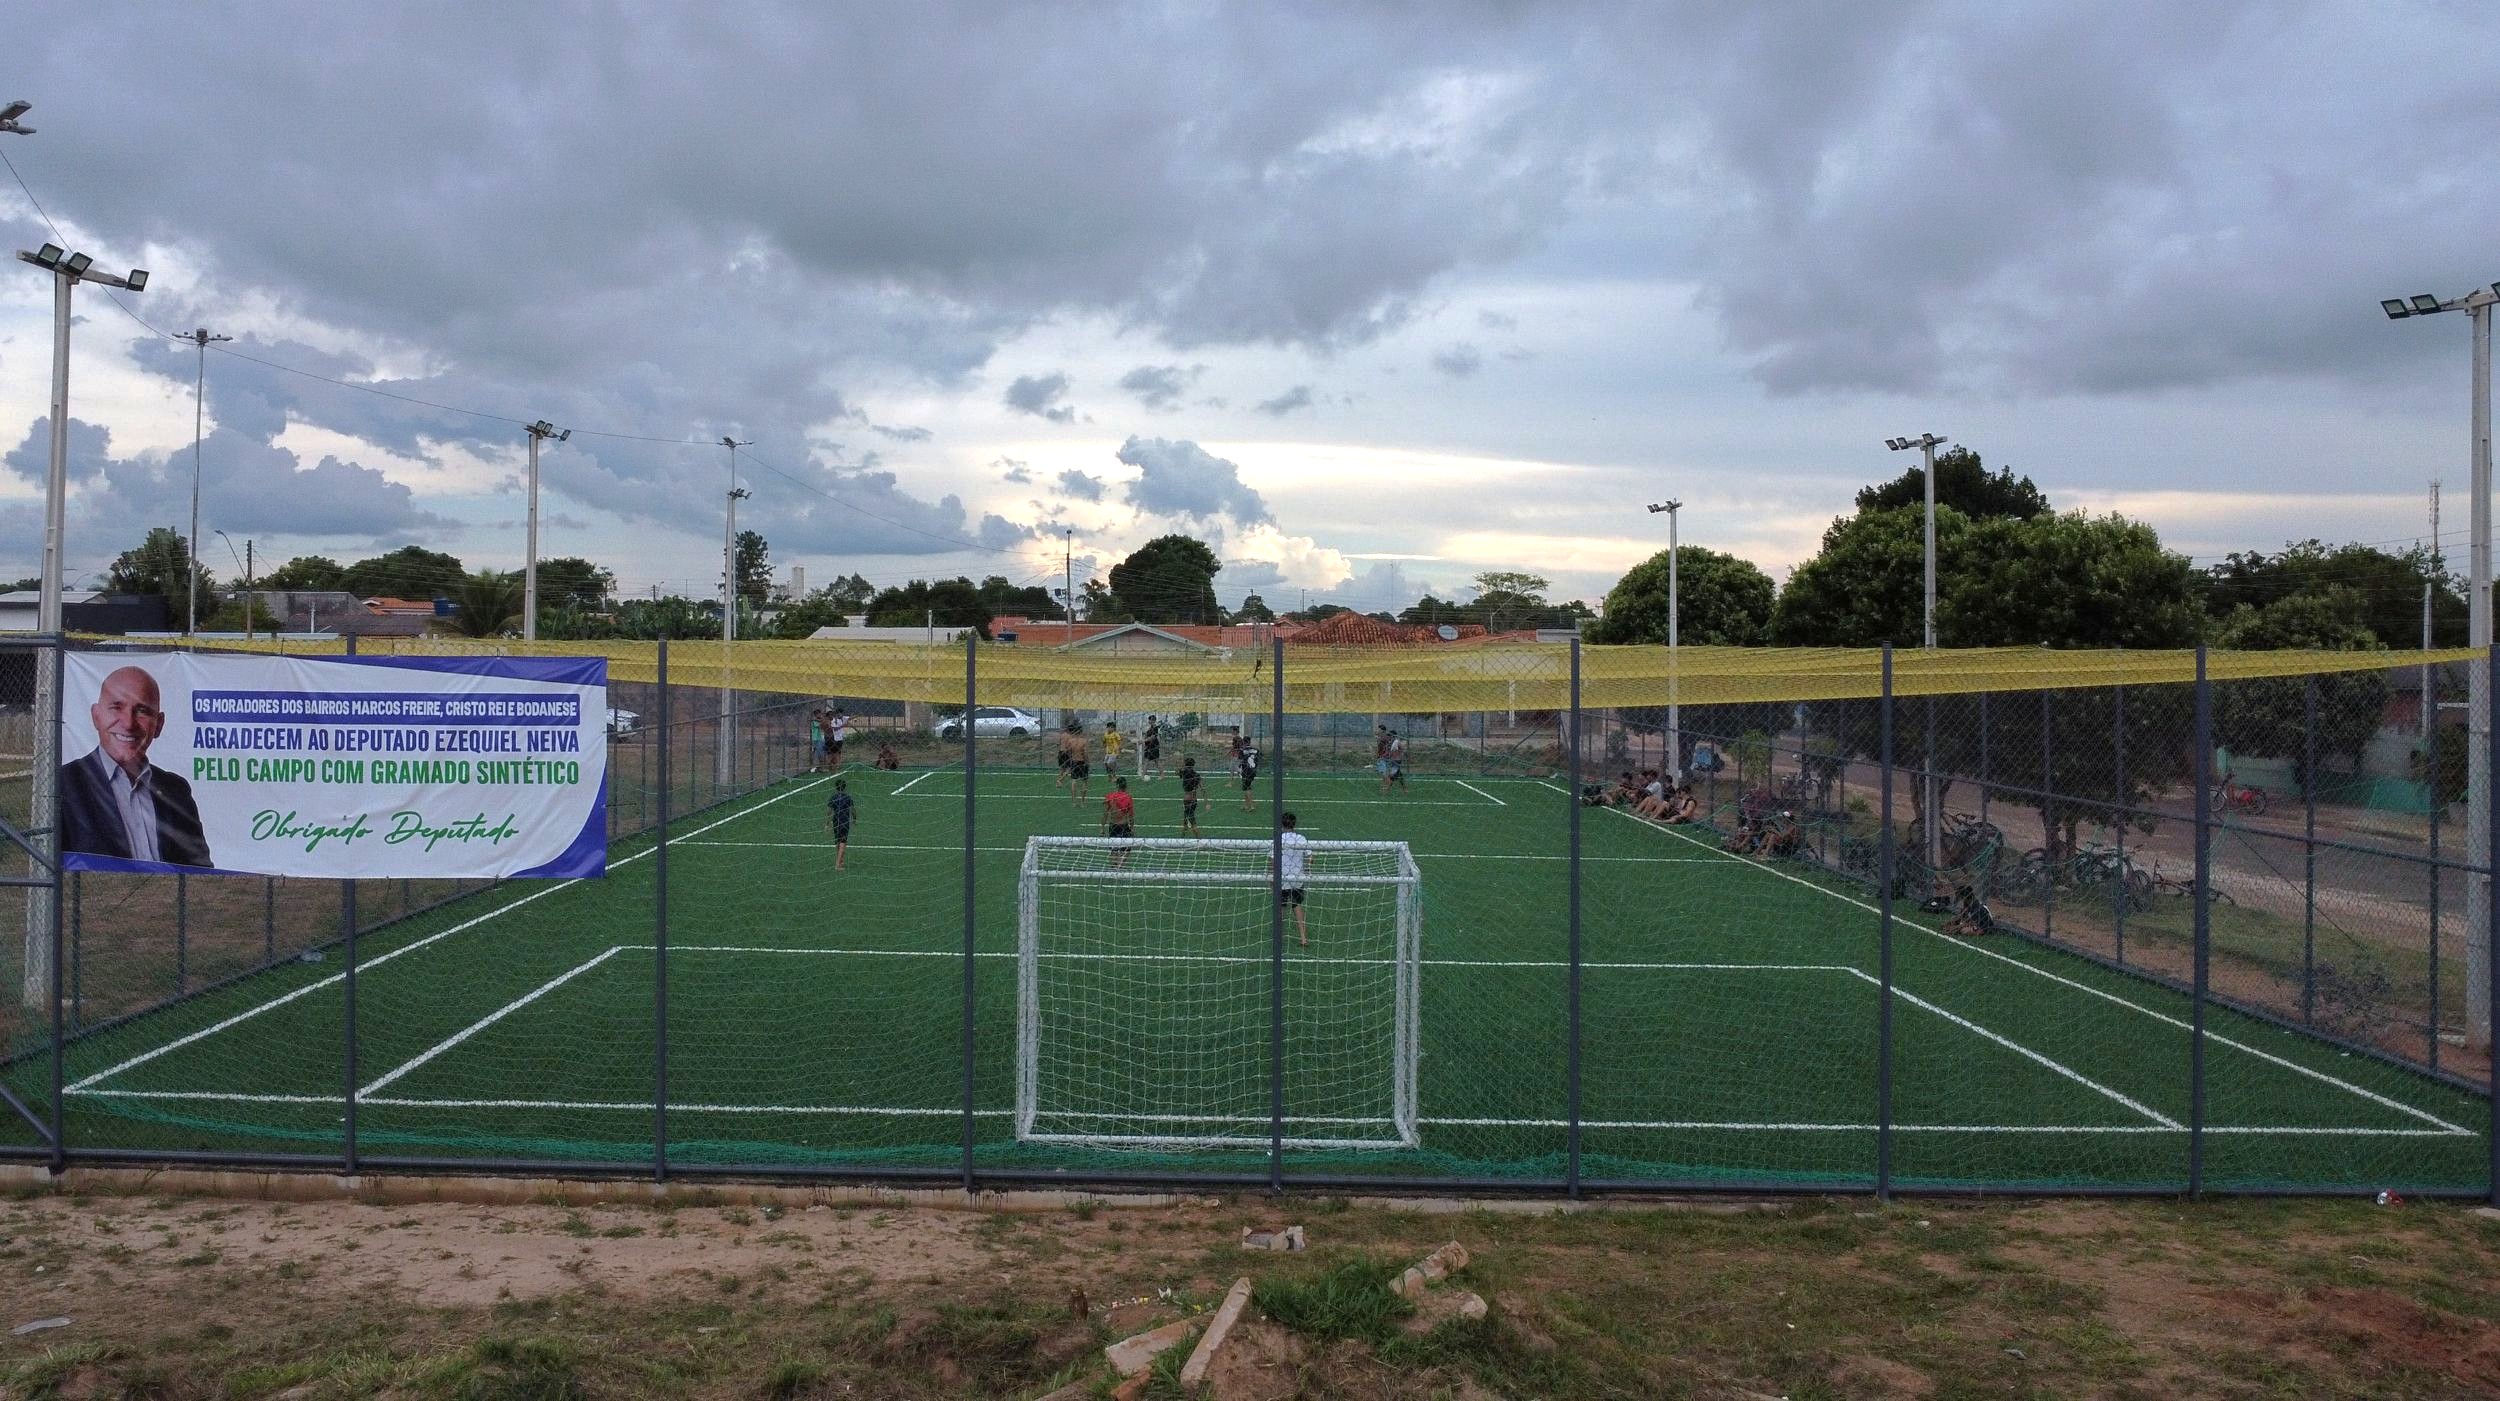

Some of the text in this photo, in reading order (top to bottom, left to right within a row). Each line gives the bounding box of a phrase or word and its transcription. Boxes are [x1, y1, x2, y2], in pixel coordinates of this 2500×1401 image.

[195, 698, 577, 717] OS MORADORES DOS BAIRROS MARCOS FREIRE, CRISTO REI E BODANESE
[193, 726, 580, 753] AGRADECEM AO DEPUTADO EZEQUIEL NEIVA
[193, 756, 580, 785] PELO CAMPO COM GRAMADO SINTÉTICO
[251, 809, 519, 853] Obrigado Deputado
